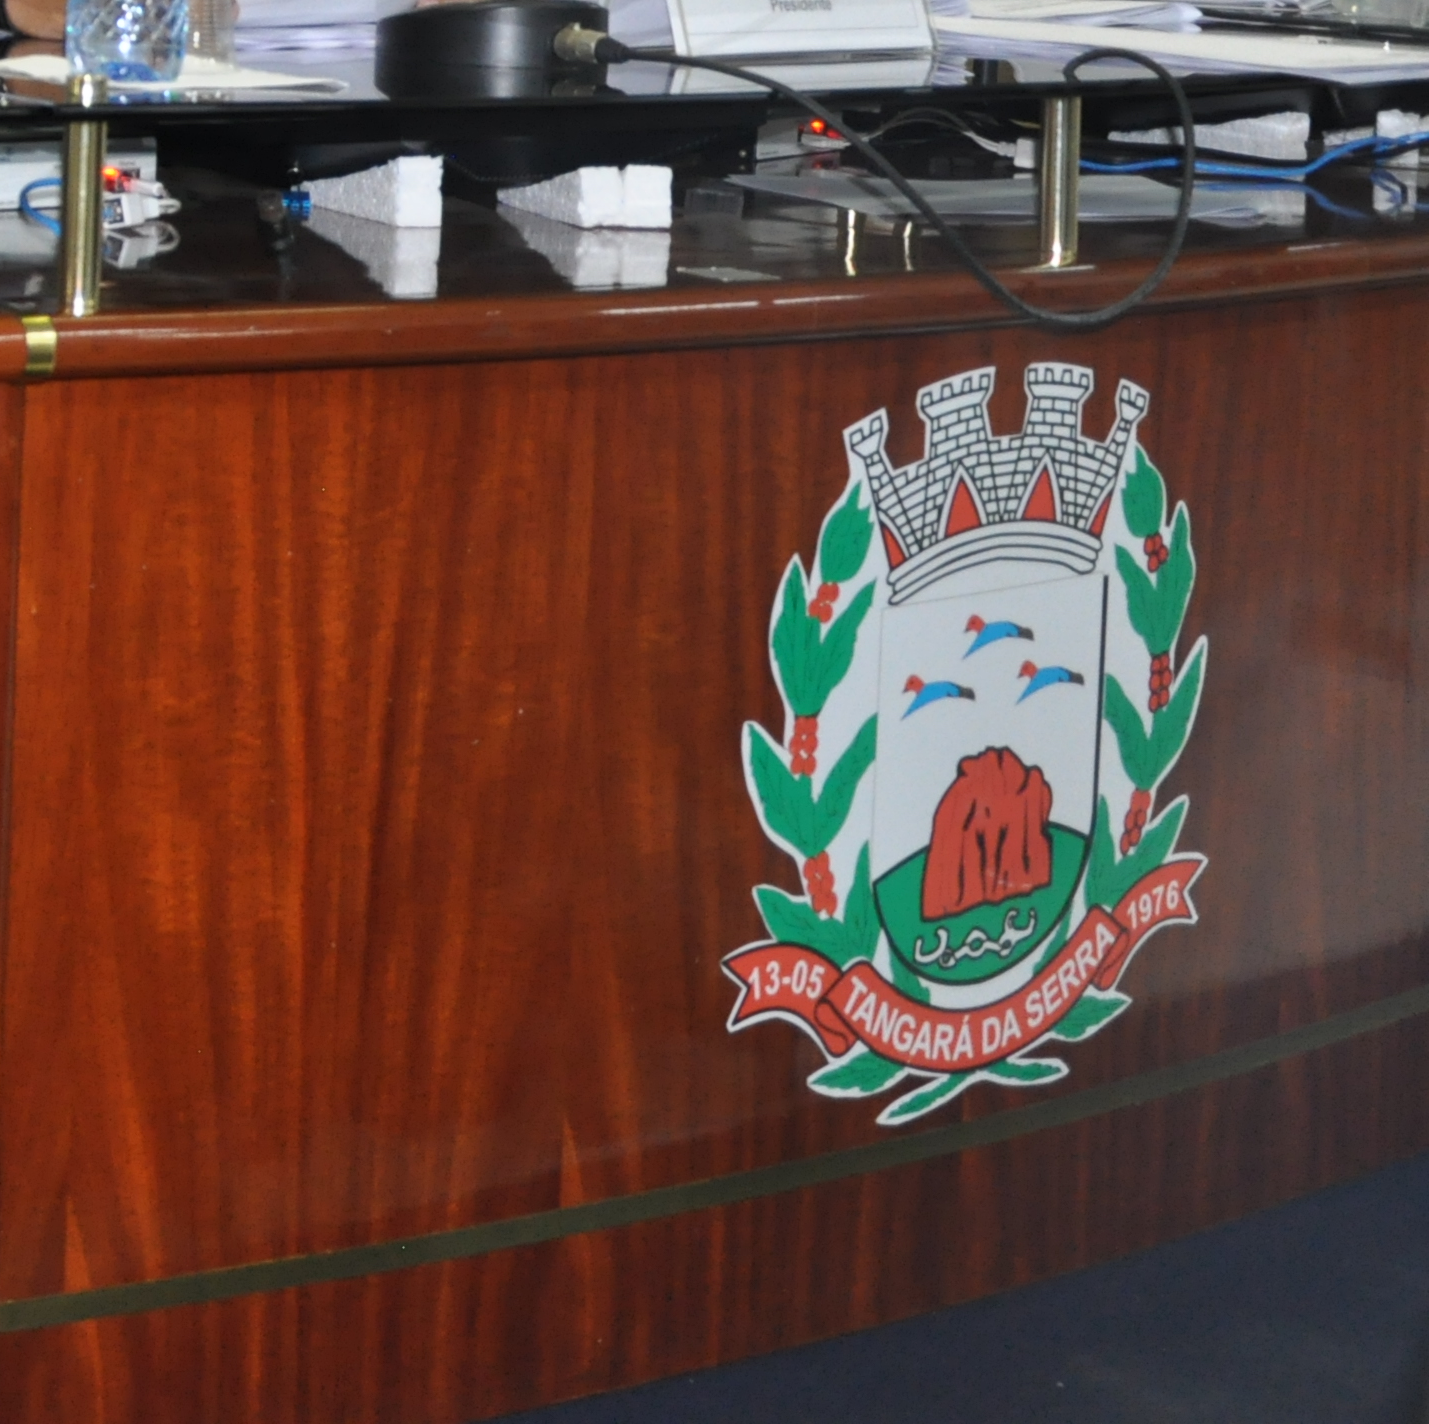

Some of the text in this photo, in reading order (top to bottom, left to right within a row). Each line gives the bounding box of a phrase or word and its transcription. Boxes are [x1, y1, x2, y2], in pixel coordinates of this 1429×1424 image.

[1126, 879, 1180, 931] 1976
[747, 922, 1116, 1062] 13-05 TANGARÁ DA SERRA
